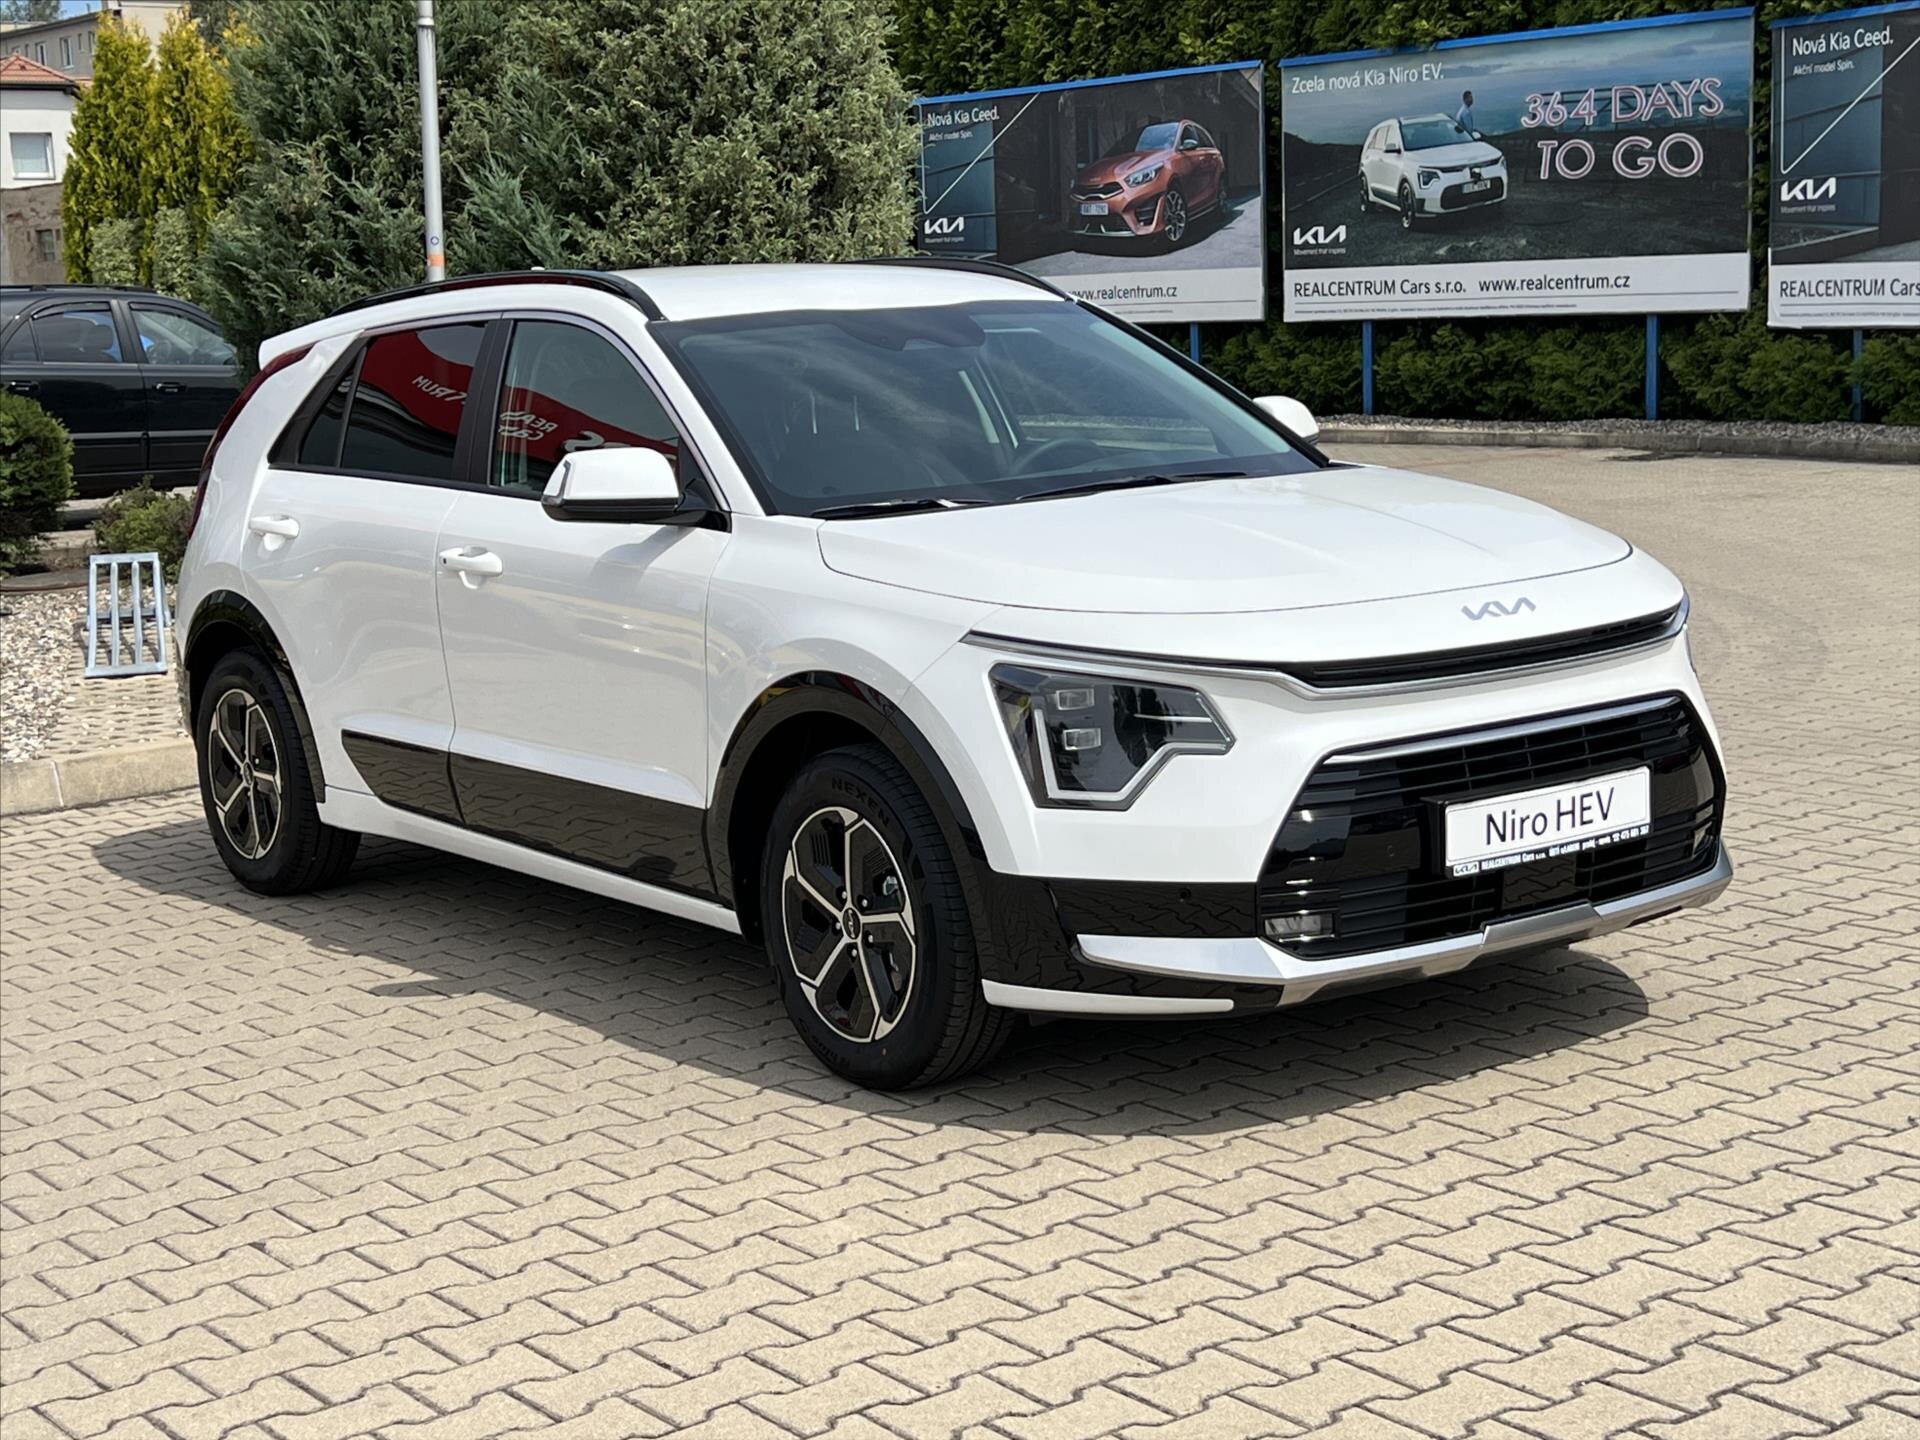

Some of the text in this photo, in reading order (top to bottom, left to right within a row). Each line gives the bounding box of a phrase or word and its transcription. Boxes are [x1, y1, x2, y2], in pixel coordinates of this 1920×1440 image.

[1792, 25, 1894, 56] Nová Kia Ceed.
[1292, 62, 1444, 94] Zcela nová Kia Niro EV.
[1521, 77, 1724, 128] 364 DAYS
[927, 106, 1000, 126] Nová Kia Ceed.
[1537, 132, 1704, 180] TO GO
[1781, 177, 1837, 201] KIA
[924, 217, 964, 234] KIA
[1293, 225, 1346, 245] KIA
[1294, 275, 1630, 297] REALCENTRUM Cars s.r.o. www.realcentrum.cz
[1780, 279, 1920, 298] REALCENTRUM Cars
[1461, 597, 1536, 620] KIA
[832, 777, 888, 827] NEXEN
[1486, 787, 1614, 845] Niro HEV
